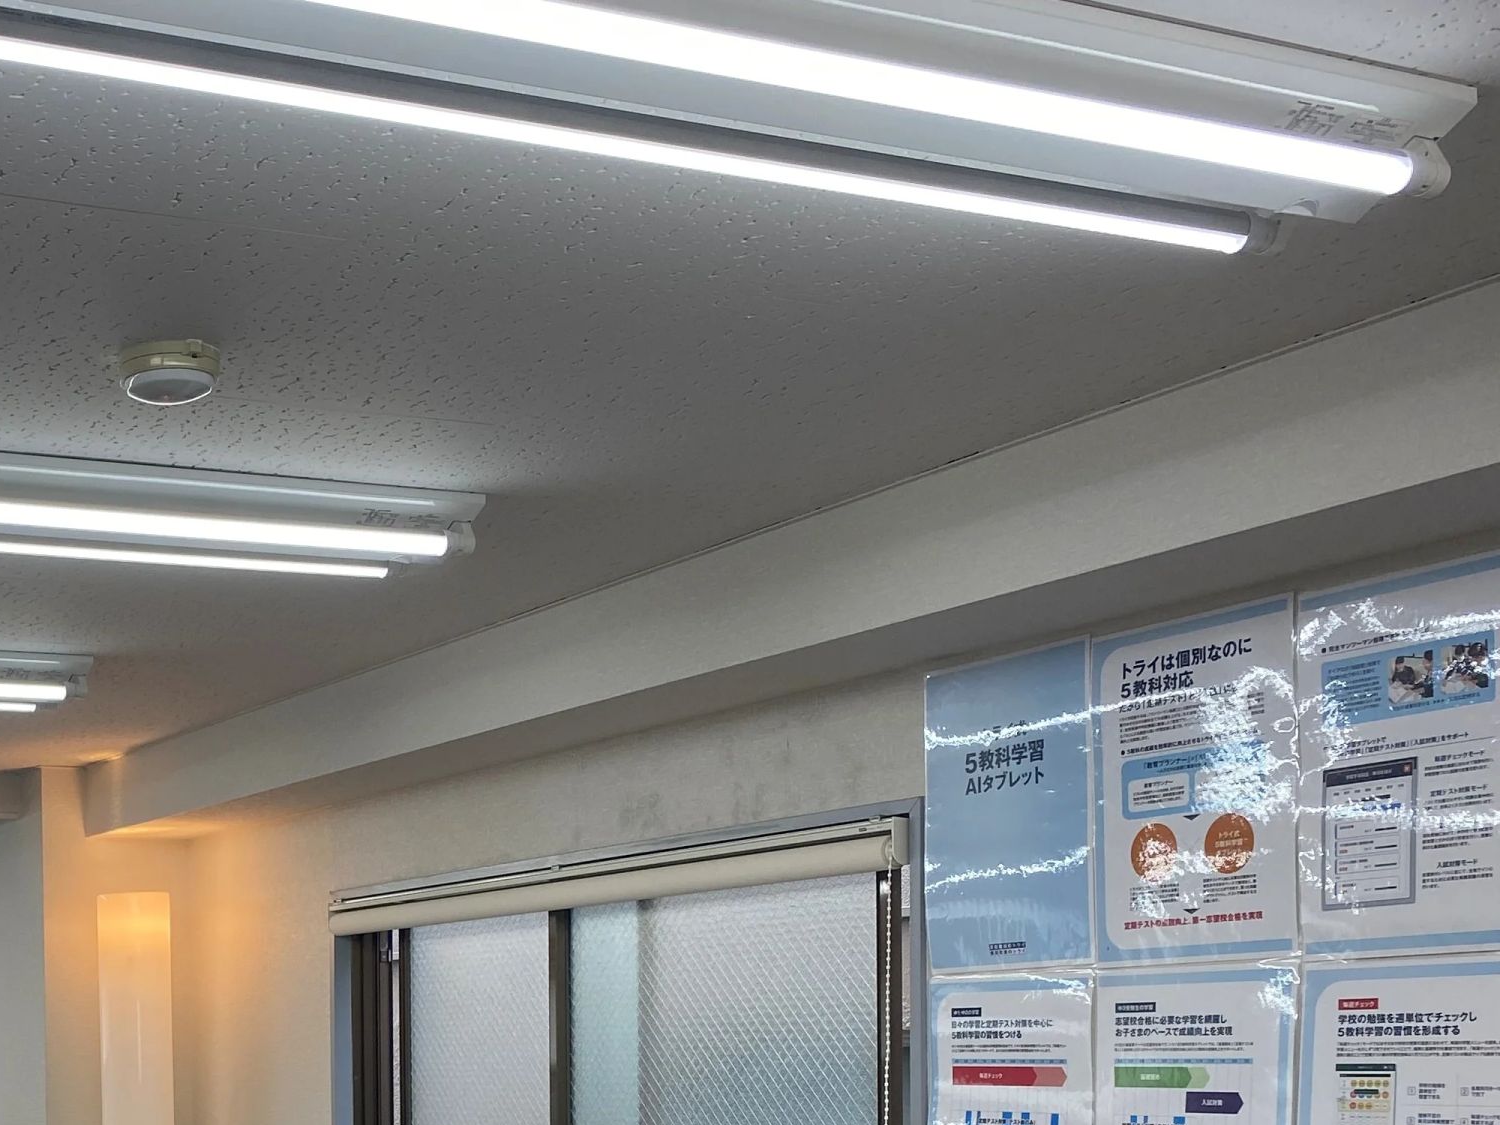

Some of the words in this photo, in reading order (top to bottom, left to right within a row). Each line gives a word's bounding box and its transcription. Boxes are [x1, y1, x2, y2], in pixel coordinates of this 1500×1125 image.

[1121, 637, 1253, 680] トライは個別なのに
[1120, 670, 1194, 699] 5教科対応
[964, 739, 1045, 774] 5教科学習
[965, 766, 1045, 796] AIタブレット
[1338, 1011, 1477, 1025] 学校の勉強を週単位でチェックし
[951, 1030, 1022, 1040] 5教科学習の習慣をつける
[1115, 1026, 1233, 1037] お子さまのペースで成績向上を実現
[1338, 1024, 1461, 1037] 5教科学習の習慣を形成する
